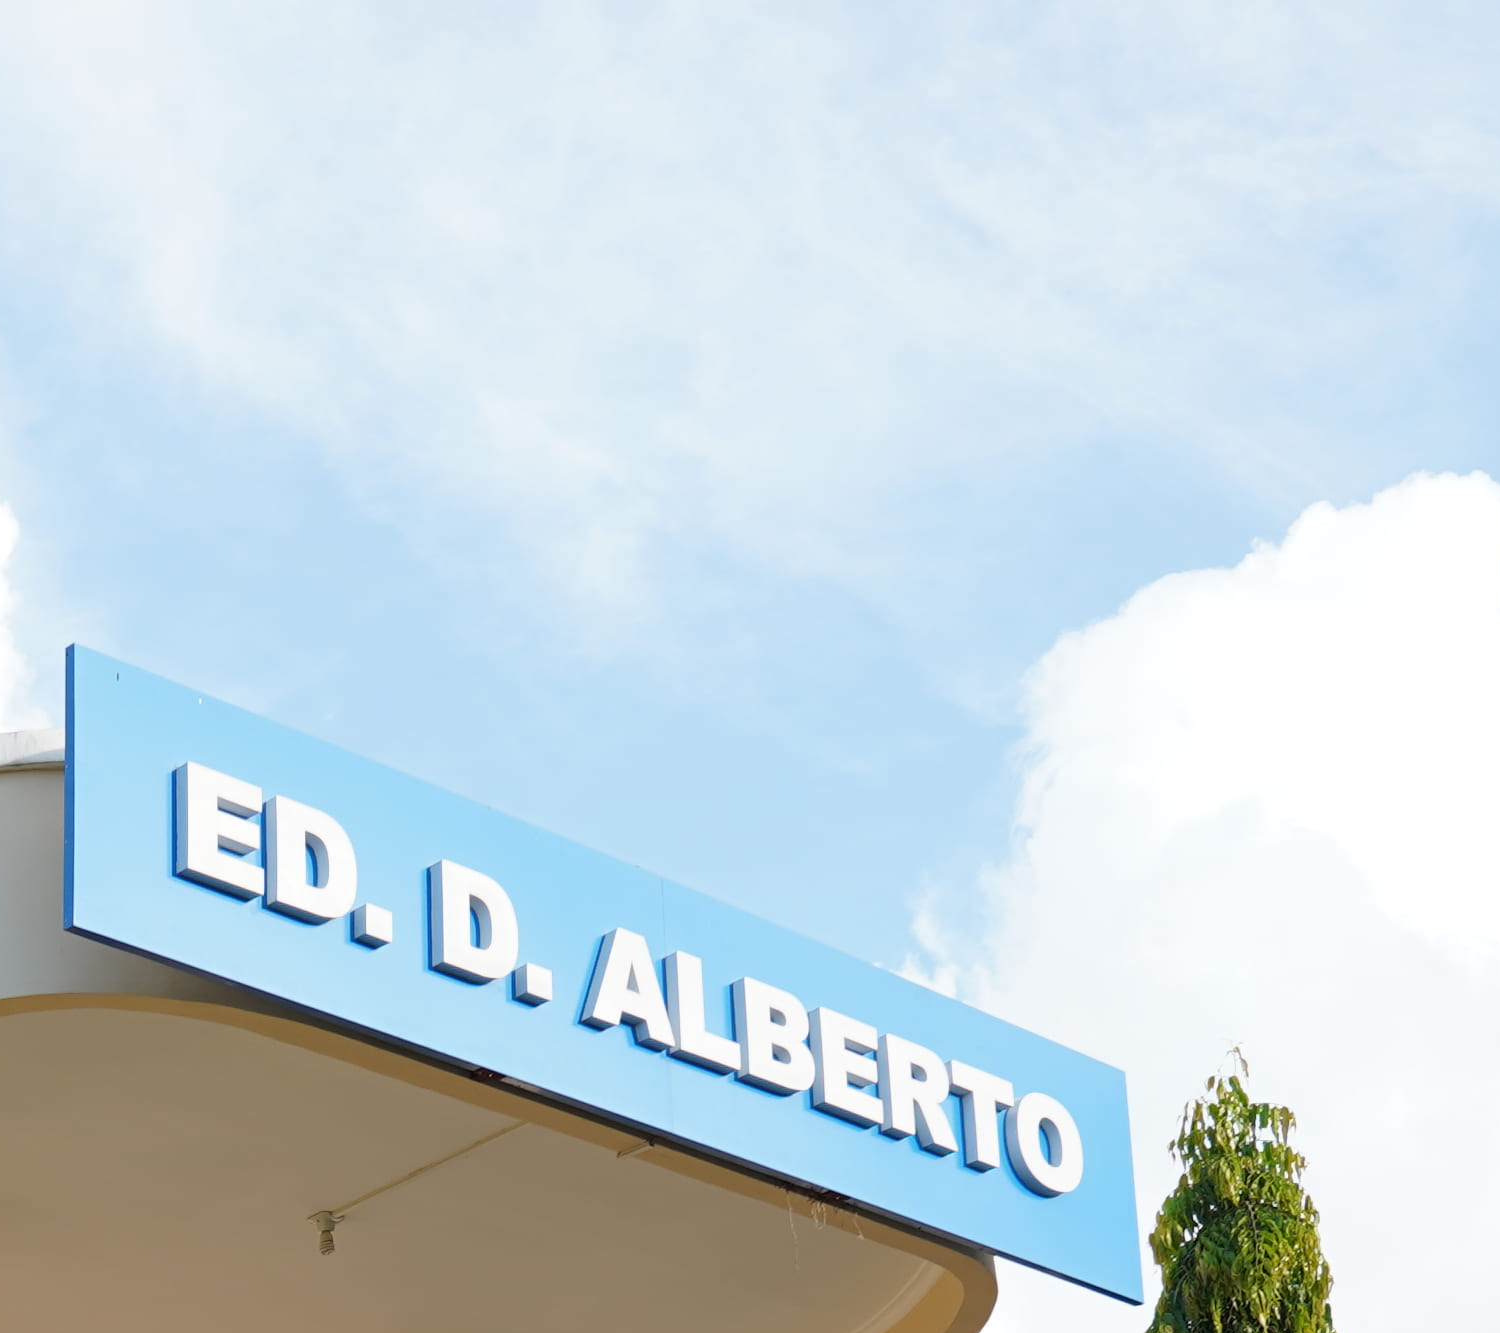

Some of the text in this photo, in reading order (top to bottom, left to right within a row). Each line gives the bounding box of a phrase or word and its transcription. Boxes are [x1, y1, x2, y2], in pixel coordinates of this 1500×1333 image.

[174, 761, 1084, 1197] ED. D. ALBERTO
